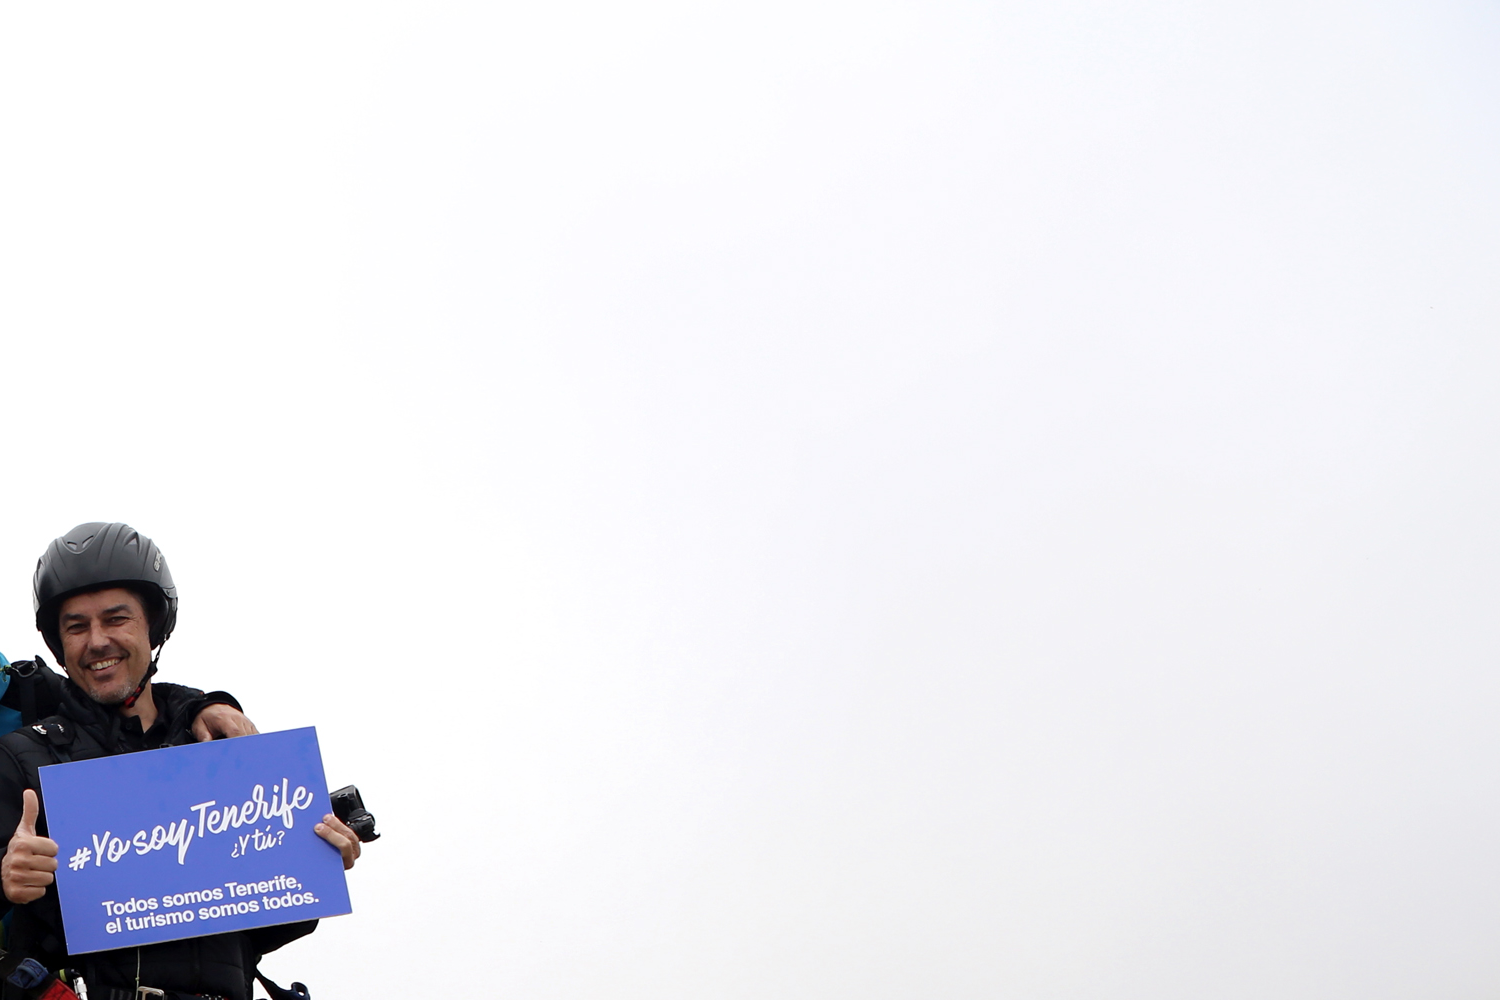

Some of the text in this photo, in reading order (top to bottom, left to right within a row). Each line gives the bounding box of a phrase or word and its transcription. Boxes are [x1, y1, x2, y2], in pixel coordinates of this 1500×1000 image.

[68, 778, 313, 871] #Yo soy Tenerife
[102, 875, 302, 917] Todos somos Tenerife,
[105, 891, 319, 934] el turismo somos todos.
